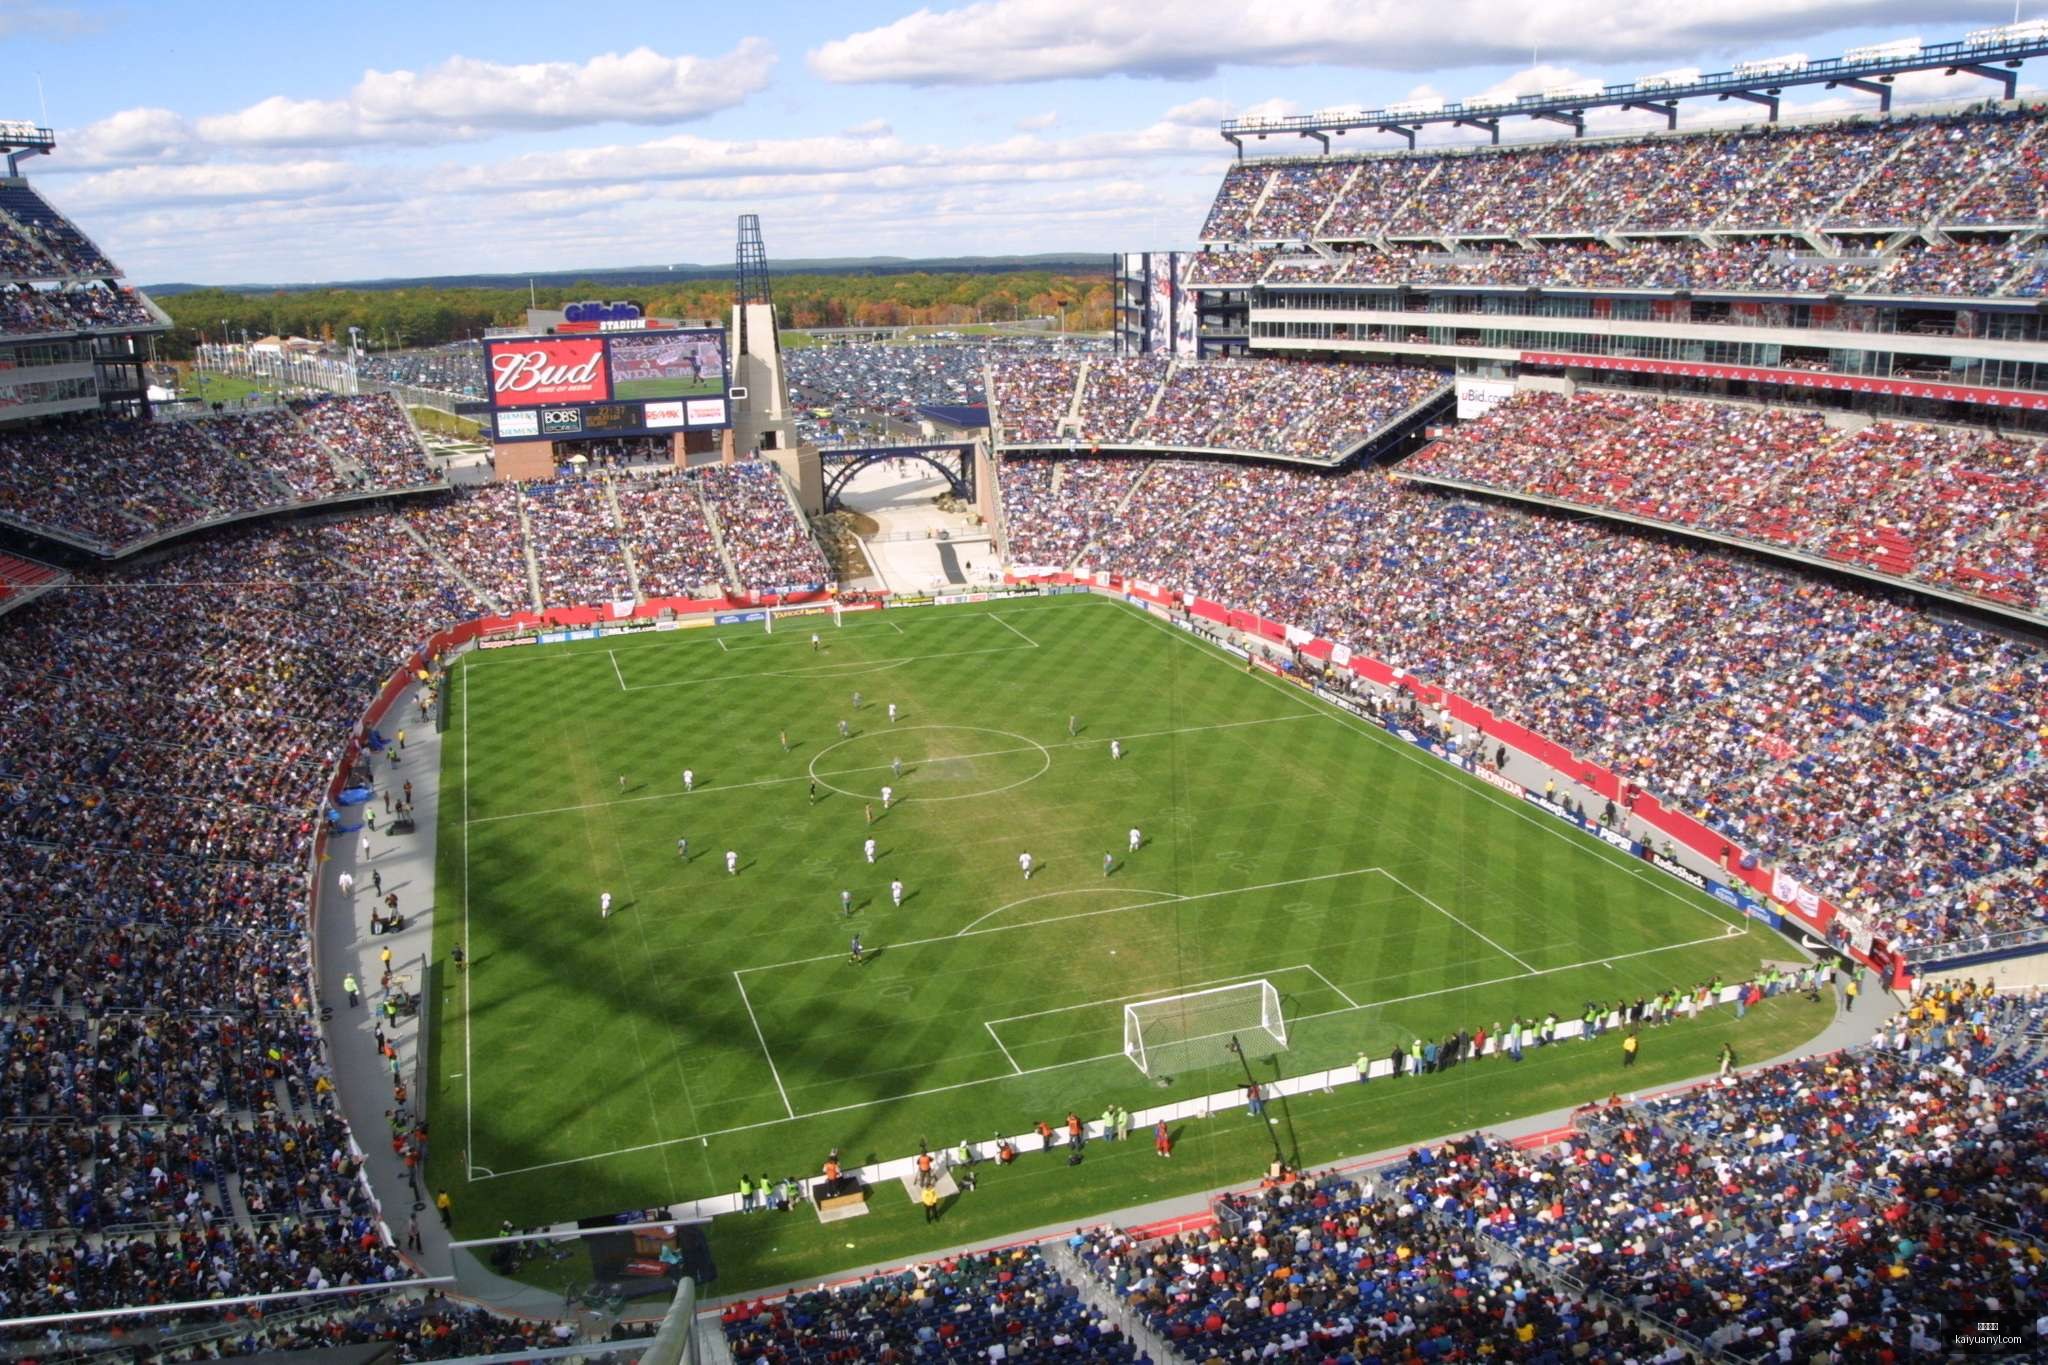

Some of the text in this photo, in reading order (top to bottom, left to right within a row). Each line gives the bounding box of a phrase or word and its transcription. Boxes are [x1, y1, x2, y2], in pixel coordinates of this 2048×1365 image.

[564, 302, 639, 323] Gillette
[600, 319, 646, 331] STADIUM
[492, 351, 602, 392] Bud
[545, 410, 578, 424] BOB'S
[1475, 765, 1525, 799] HONDA
[1600, 826, 1632, 852] PEPSI
